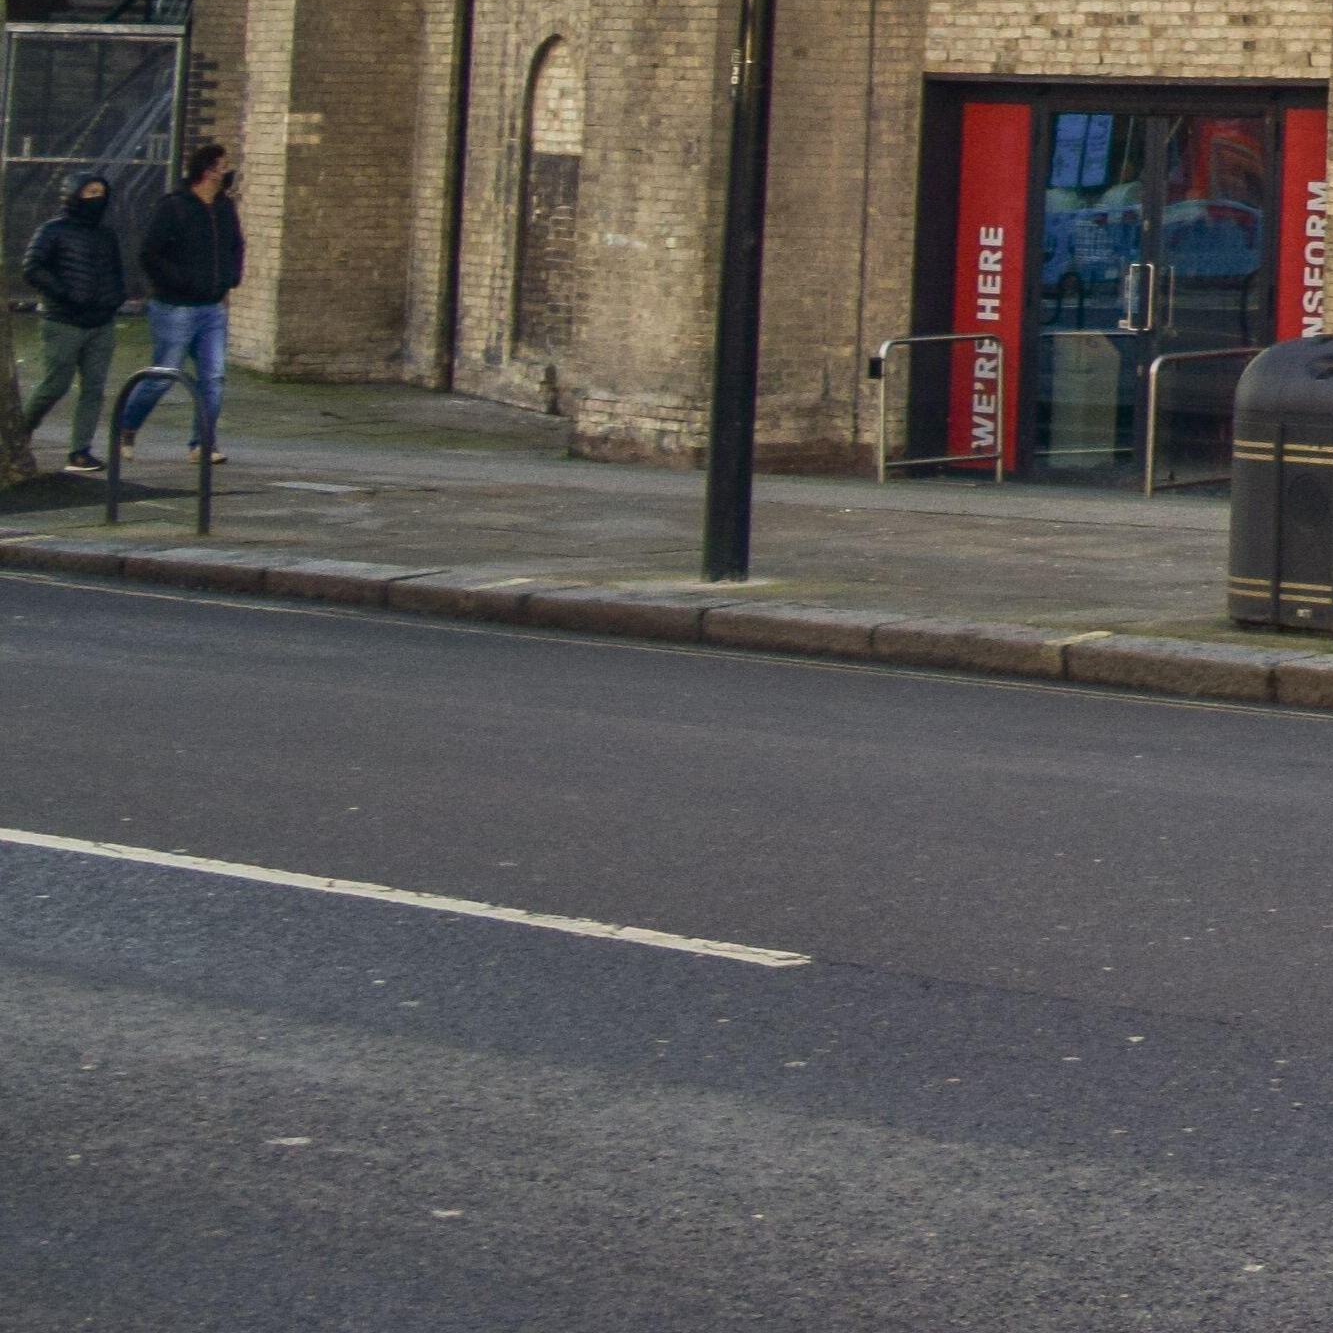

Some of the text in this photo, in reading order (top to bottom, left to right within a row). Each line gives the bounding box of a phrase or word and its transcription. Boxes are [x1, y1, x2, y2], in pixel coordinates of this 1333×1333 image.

[971, 226, 1004, 455] WE'RE HERE
[1302, 181, 1328, 338] NSFORM
